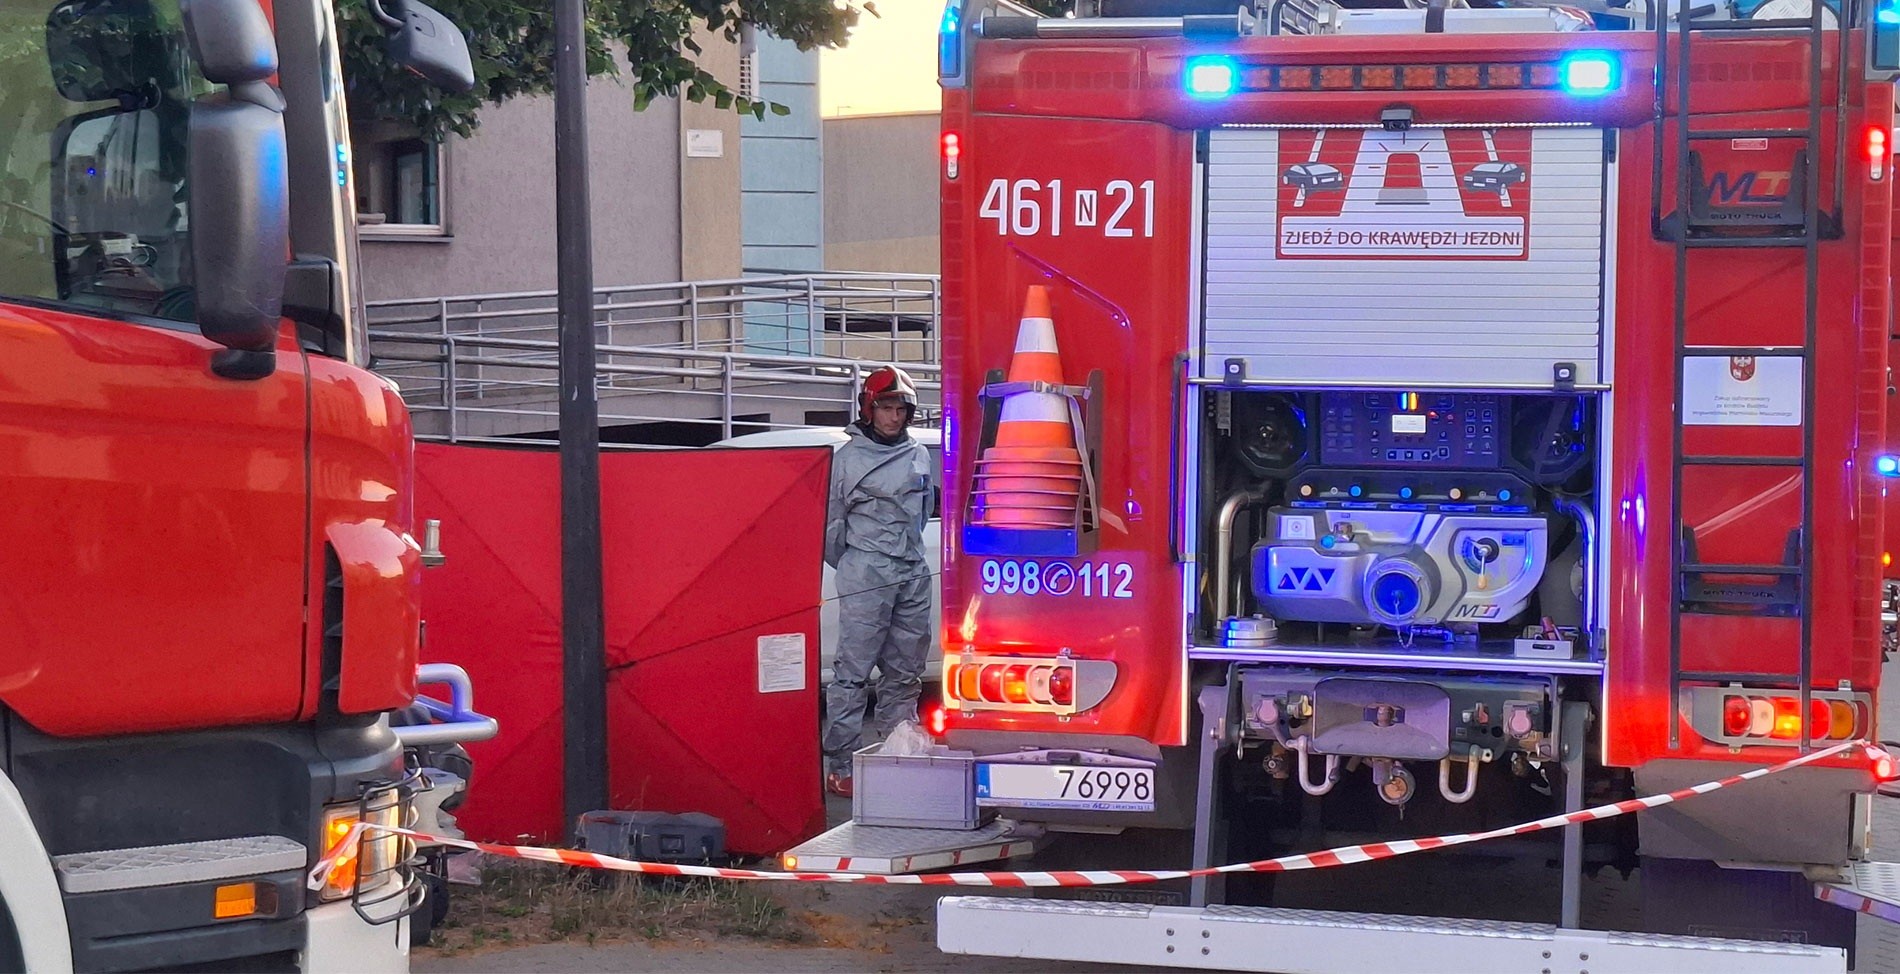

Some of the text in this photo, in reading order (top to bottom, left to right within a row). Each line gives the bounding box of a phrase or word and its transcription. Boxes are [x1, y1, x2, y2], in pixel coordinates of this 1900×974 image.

[979, 178, 1155, 238] 461 N 21
[1285, 228, 1520, 249] ZJEDŹ DO KRAWĘDZI JEZDNI
[982, 560, 1134, 598] 998 112
[978, 784, 989, 794] PL
[1058, 769, 1151, 801] 76998
